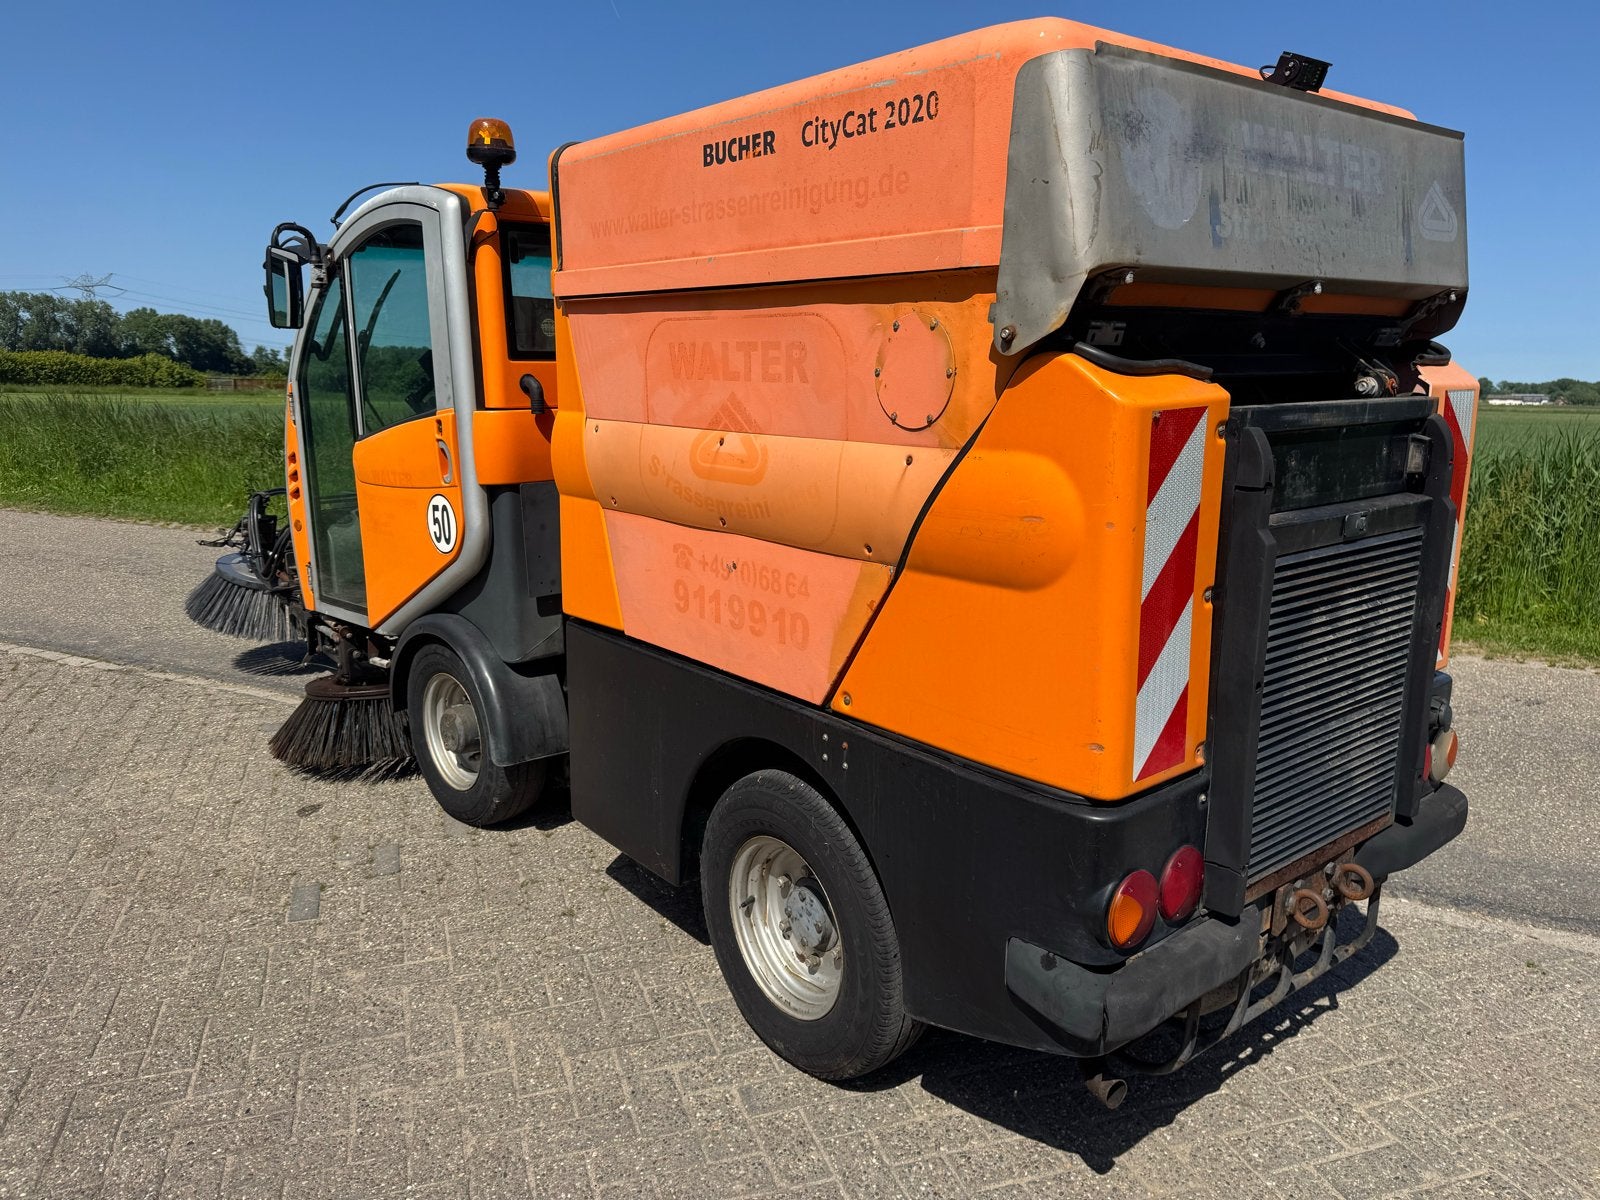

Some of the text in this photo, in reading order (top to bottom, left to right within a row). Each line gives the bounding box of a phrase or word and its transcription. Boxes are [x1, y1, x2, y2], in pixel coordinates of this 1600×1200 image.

[703, 90, 939, 167] BUCHER CityCat 2020
[589, 163, 910, 240] www.walter-strassenreinigung.de
[669, 341, 809, 383] WALTER
[432, 504, 452, 546] 50
